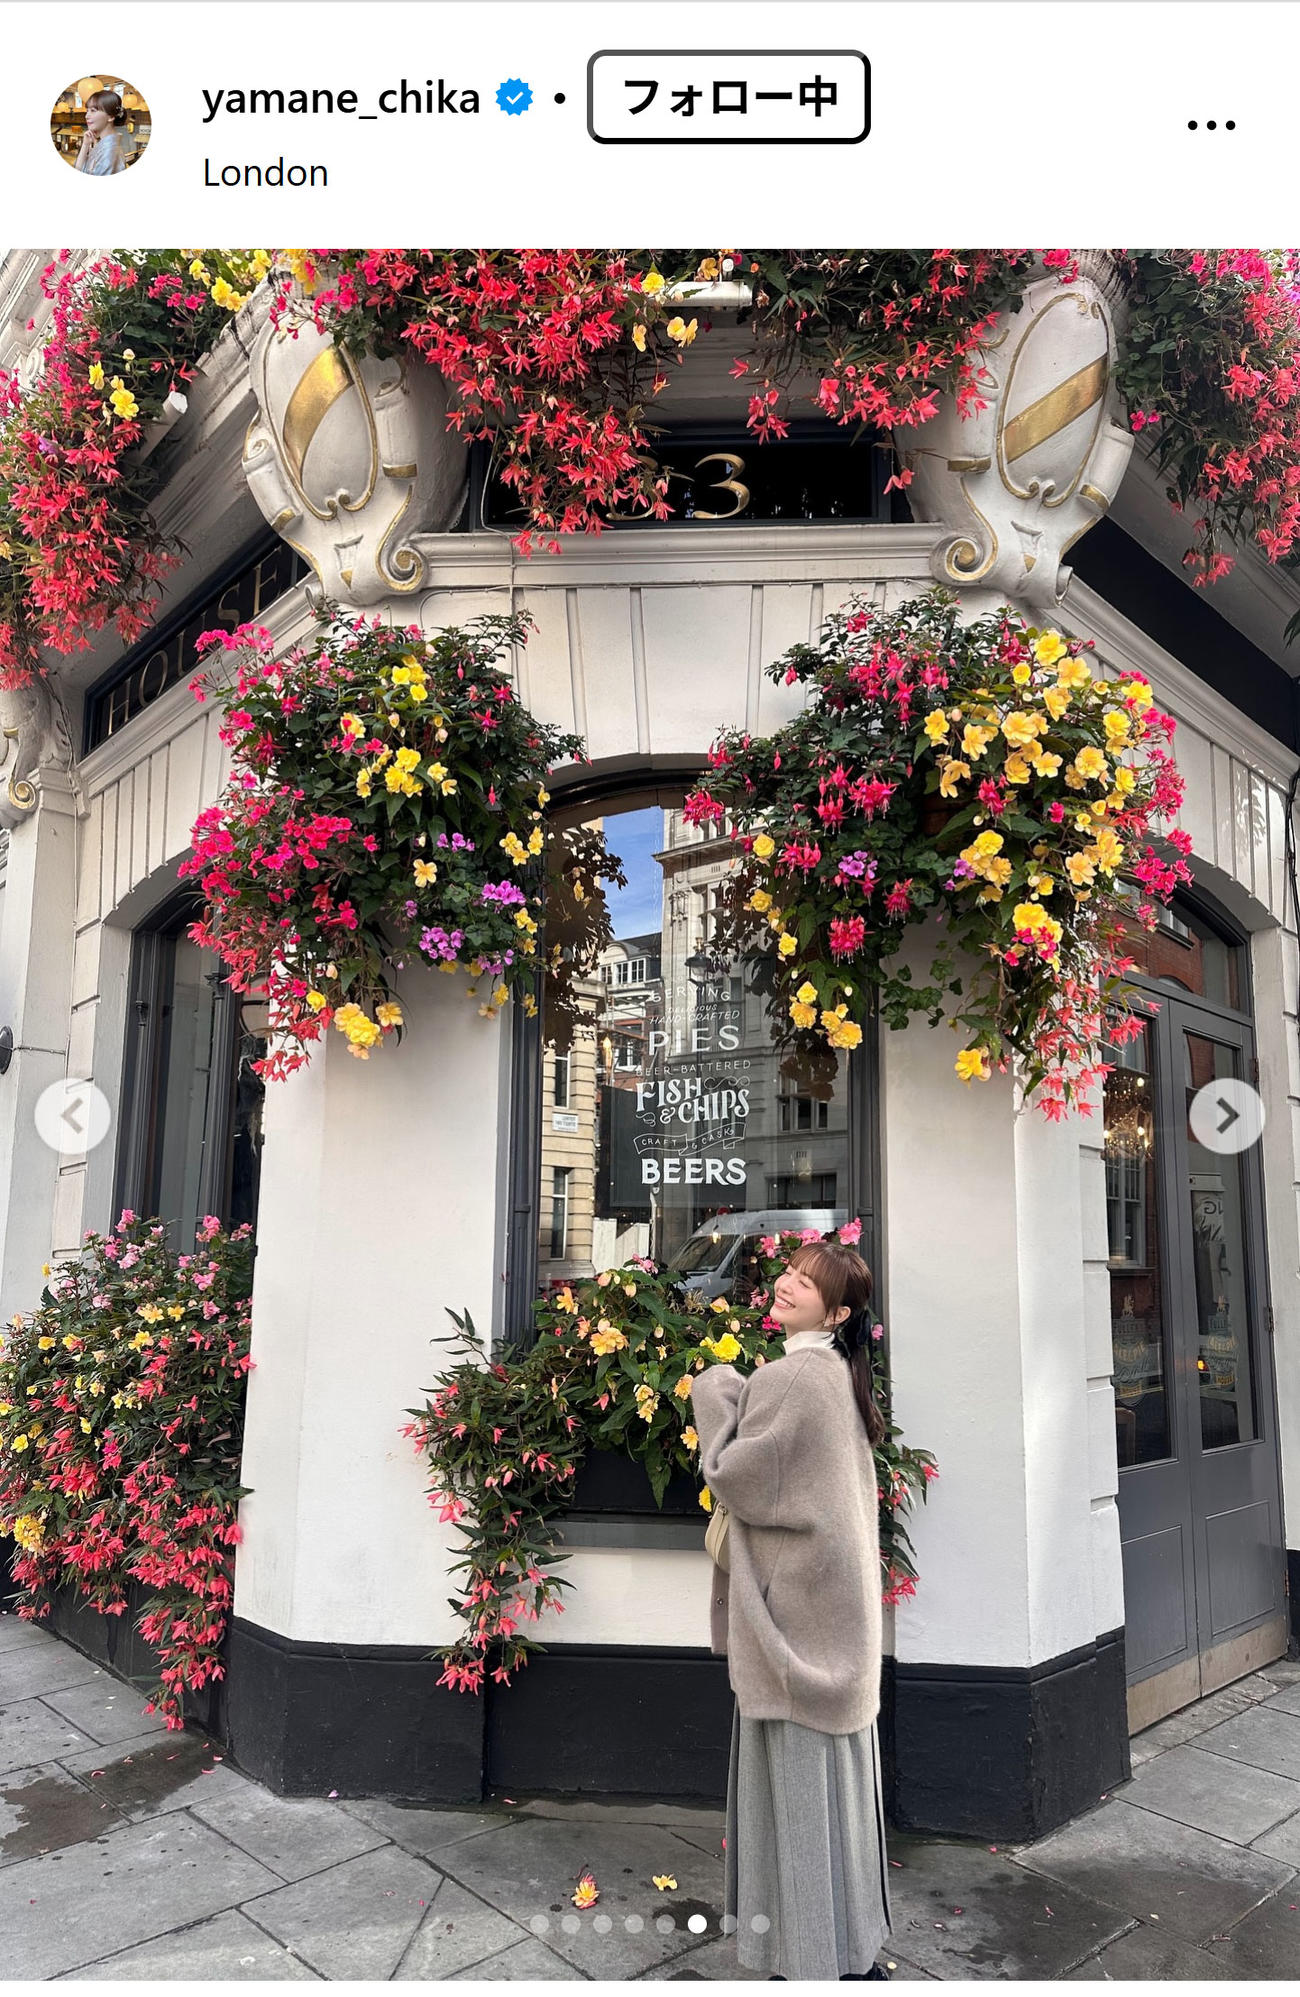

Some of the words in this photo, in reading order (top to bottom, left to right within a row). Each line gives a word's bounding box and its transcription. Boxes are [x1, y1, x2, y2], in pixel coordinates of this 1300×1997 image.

[650, 986, 731, 1003] SERVING
[649, 1010, 740, 1025] HAND-CRAFTED
[648, 1025, 740, 1055] PIES
[636, 1060, 751, 1077] BEER-BATTERED
[636, 1077, 702, 1112] FISH
[660, 1106, 676, 1124] &
[678, 1089, 750, 1123] CHIPS
[641, 1138, 677, 1146] CRAFT
[701, 1127, 735, 1144] CASK
[641, 1158, 747, 1186] BEERS
